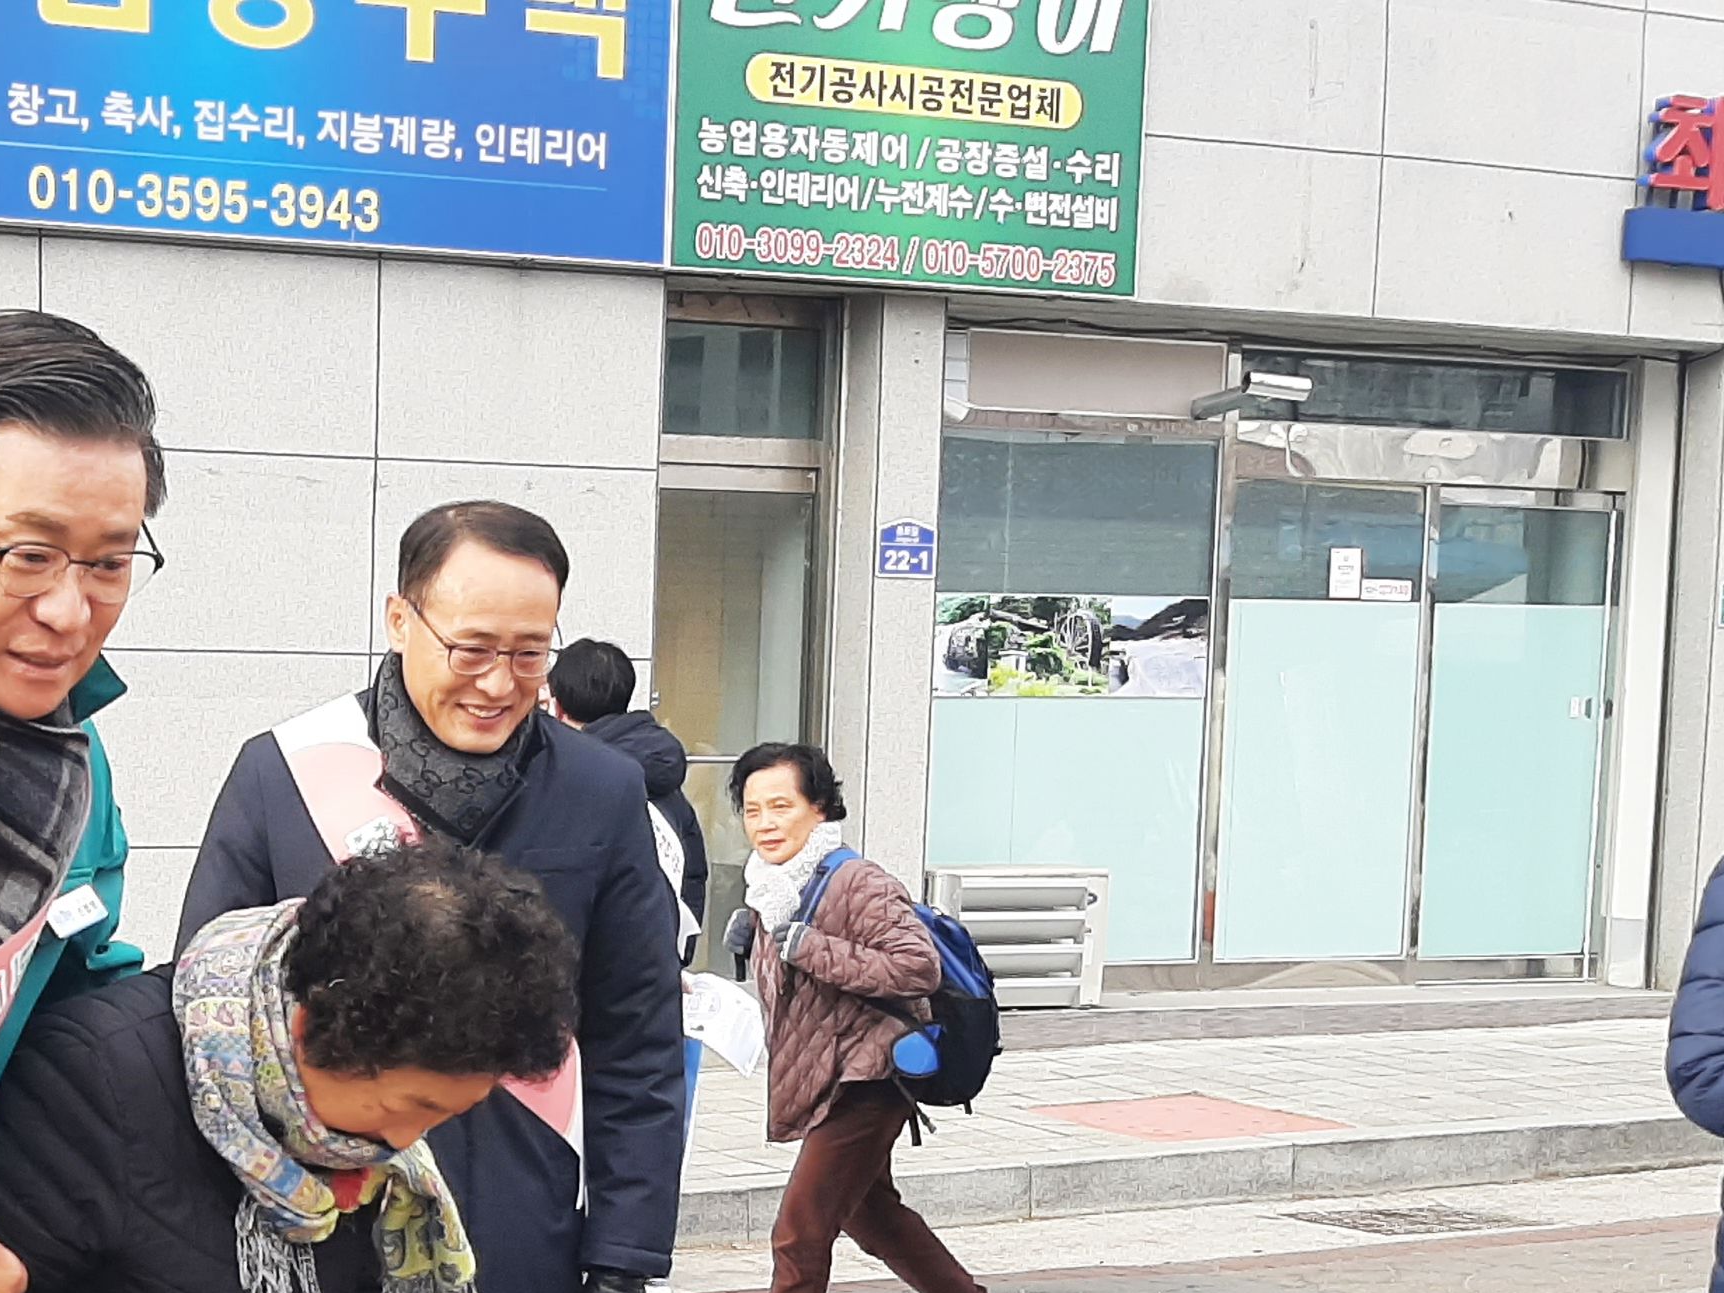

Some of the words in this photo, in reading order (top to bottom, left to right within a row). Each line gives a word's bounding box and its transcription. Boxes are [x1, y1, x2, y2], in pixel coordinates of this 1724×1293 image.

[769, 61, 1061, 124] 전기공사시공전문업체
[7, 82, 90, 133] 창고,
[100, 90, 181, 139] 축사,
[193, 100, 305, 149] 집수리,
[316, 110, 463, 162] 지붕계량,
[475, 124, 607, 170] 인테리어
[697, 117, 909, 169] 농업용자동제어
[28, 164, 381, 233] 010-3595-3943
[695, 223, 898, 272] 010-3099-2324
[921, 238, 1117, 287] 010-5700-2375
[884, 549, 929, 571] 22-1
